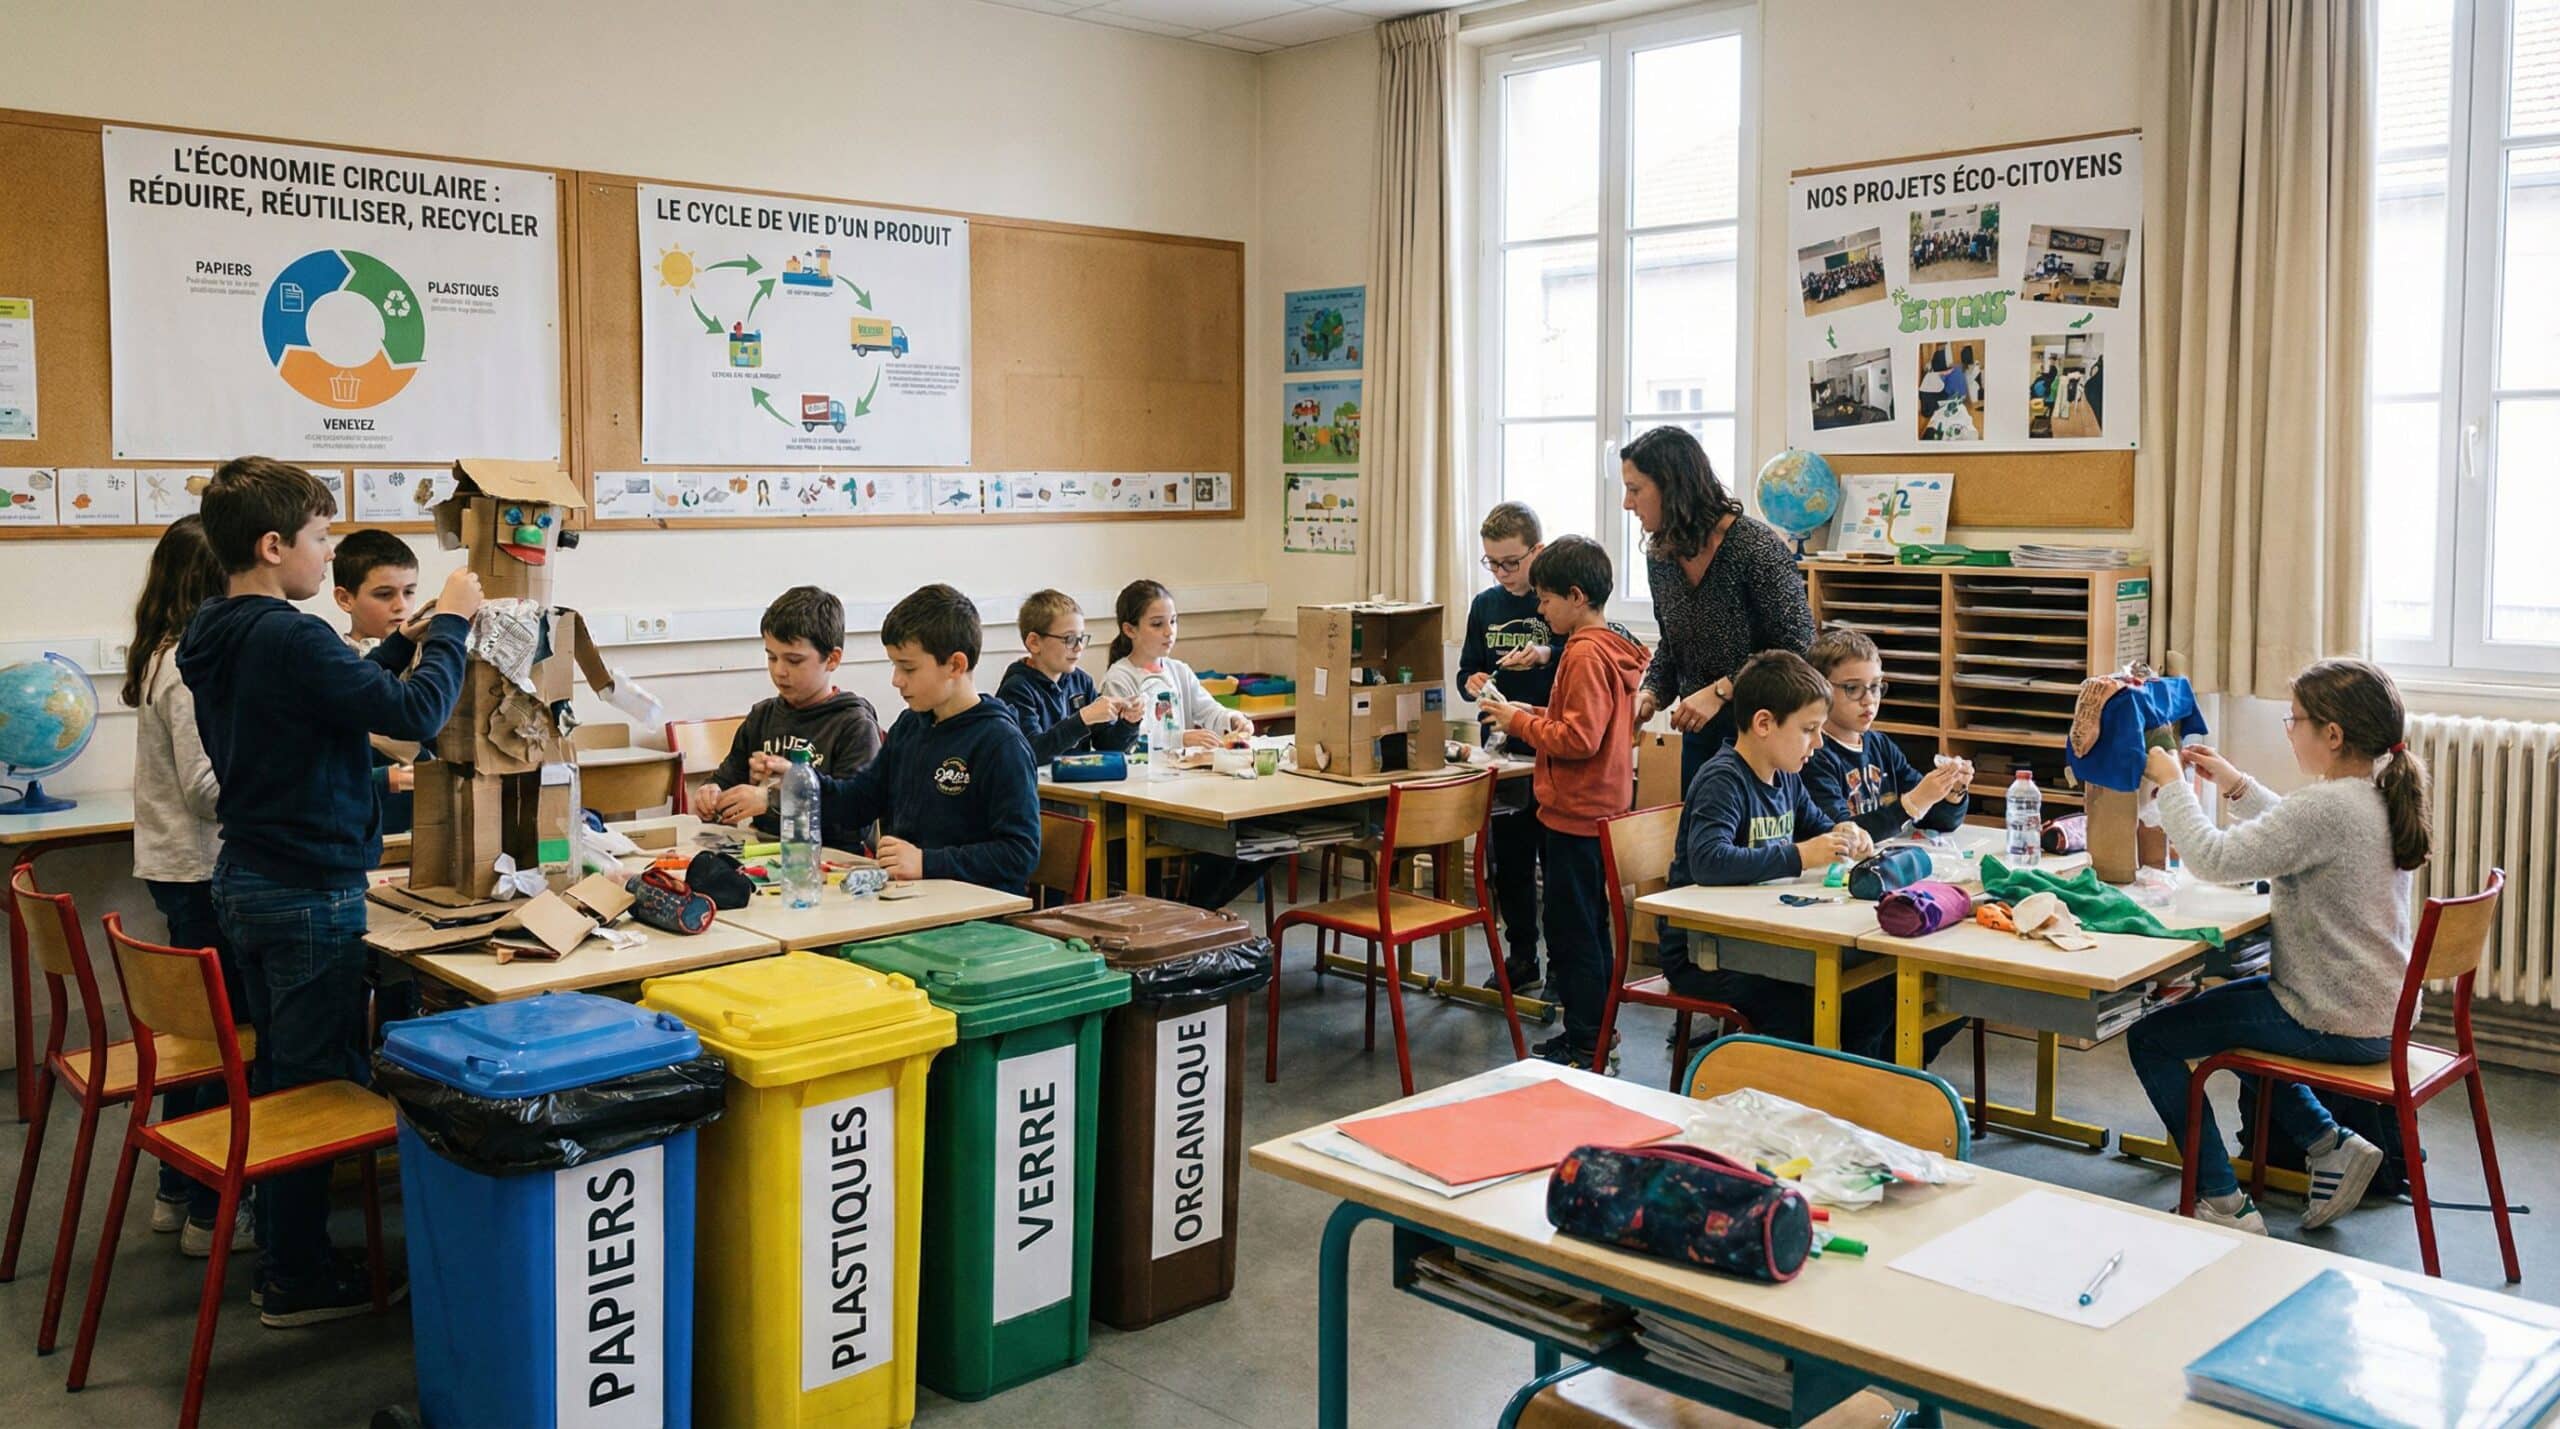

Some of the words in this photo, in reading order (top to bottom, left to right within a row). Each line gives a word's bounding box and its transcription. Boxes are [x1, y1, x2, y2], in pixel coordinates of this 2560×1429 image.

[129, 174, 253, 217] RÉDUIRE,
[262, 186, 413, 231] RÉUTILISER,
[421, 205, 539, 237] RECYCLER
[343, 165, 487, 202] CIRCULAIRE
[494, 186, 501, 203] :
[1807, 185, 1847, 210] NOS
[1853, 173, 1946, 205] PROJETS
[1953, 151, 2122, 194] ÉCO-CITOYENS
[657, 198, 681, 221] LE
[687, 201, 751, 228] CYCLE
[758, 208, 783, 231] DE
[788, 211, 819, 234] VIE
[874, 220, 951, 246] PRODUIT
[196, 260, 252, 277] PAPIERS
[428, 281, 500, 297] PLASTIQUES
[1174, 1020, 1207, 1242] ORGANIQUE
[1018, 1081, 1055, 1251] VERRE
[831, 1106, 872, 1370] PLASTIQUES
[588, 1168, 635, 1408] PAPIERS
